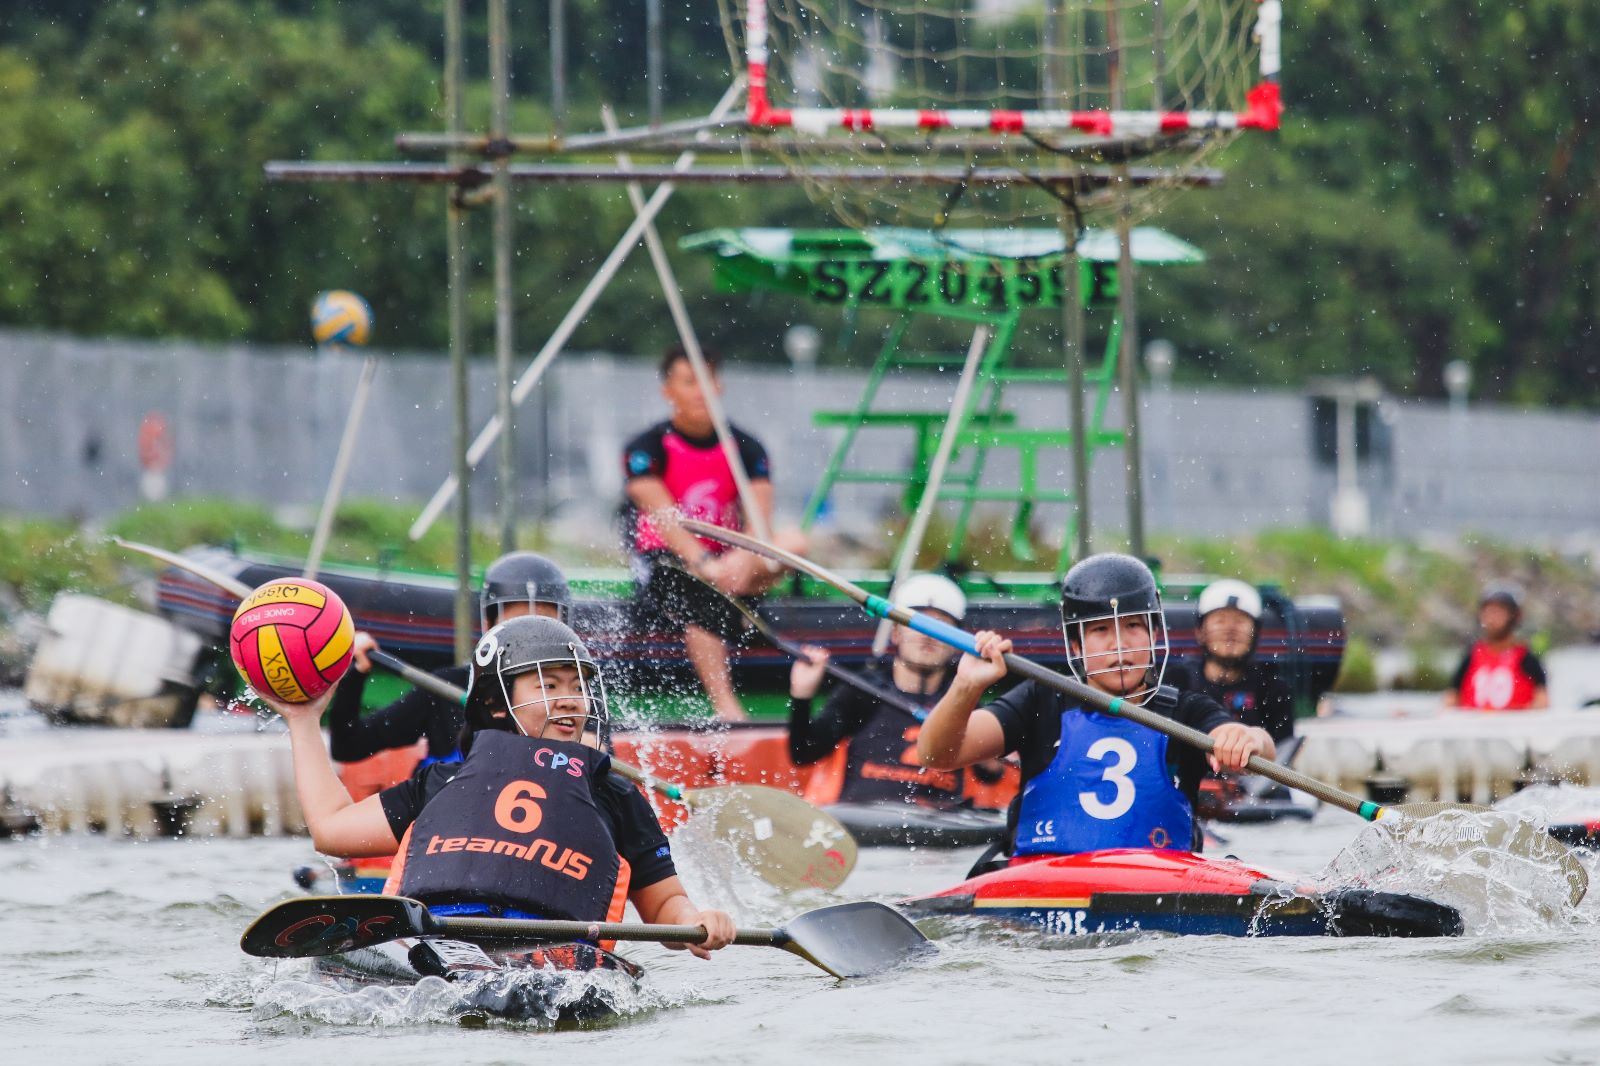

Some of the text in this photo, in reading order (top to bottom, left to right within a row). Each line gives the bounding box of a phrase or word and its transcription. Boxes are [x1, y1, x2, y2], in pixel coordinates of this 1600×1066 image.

[241, 607, 295, 626] CANOE POLO
[534, 747, 585, 777] CPS
[1078, 737, 1138, 820] 3
[494, 780, 547, 834] 6
[425, 835, 593, 881] teamNUS
